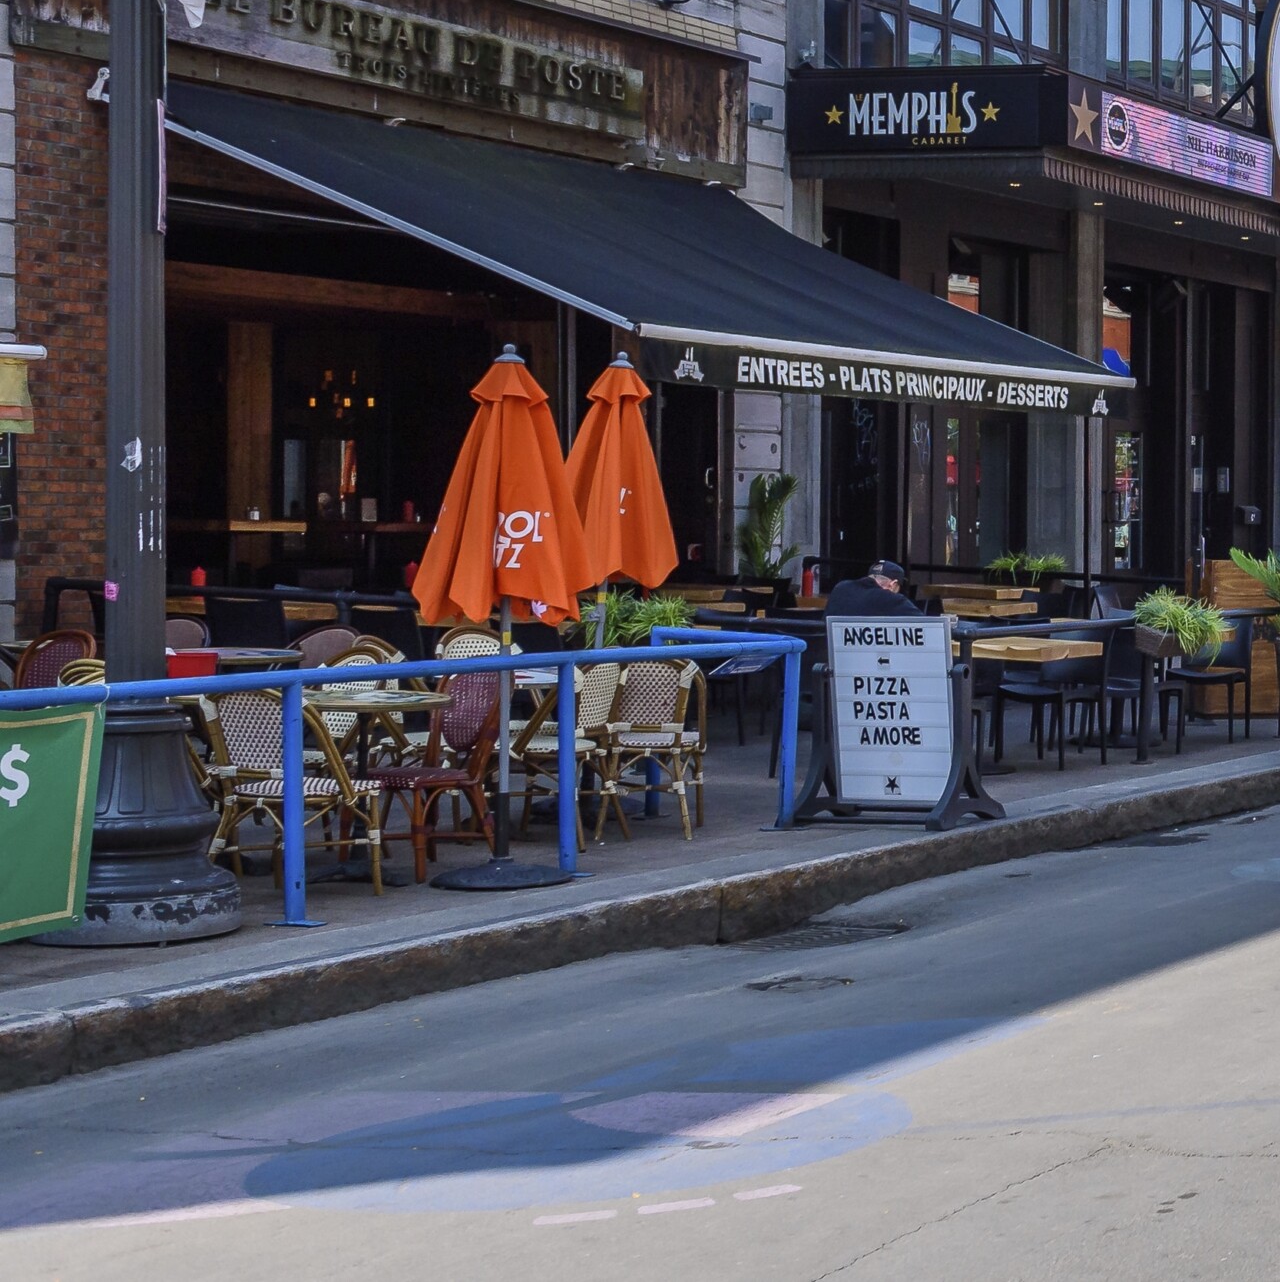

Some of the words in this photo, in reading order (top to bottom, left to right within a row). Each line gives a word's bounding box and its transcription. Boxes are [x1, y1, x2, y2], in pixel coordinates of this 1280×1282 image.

[512, 46, 628, 102] POSTE
[848, 82, 978, 136] MEMPHIS
[911, 135, 968, 146] CABARET
[736, 354, 825, 389] ENTREES
[840, 365, 892, 394] PLATS
[896, 372, 984, 402] PRINCIPAUX
[996, 381, 1069, 409] DESSERTS
[843, 626, 925, 647] ANGELINE
[853, 676, 911, 696] PIZZA
[853, 701, 910, 721] PASTA
[860, 726, 922, 746] AMORE
